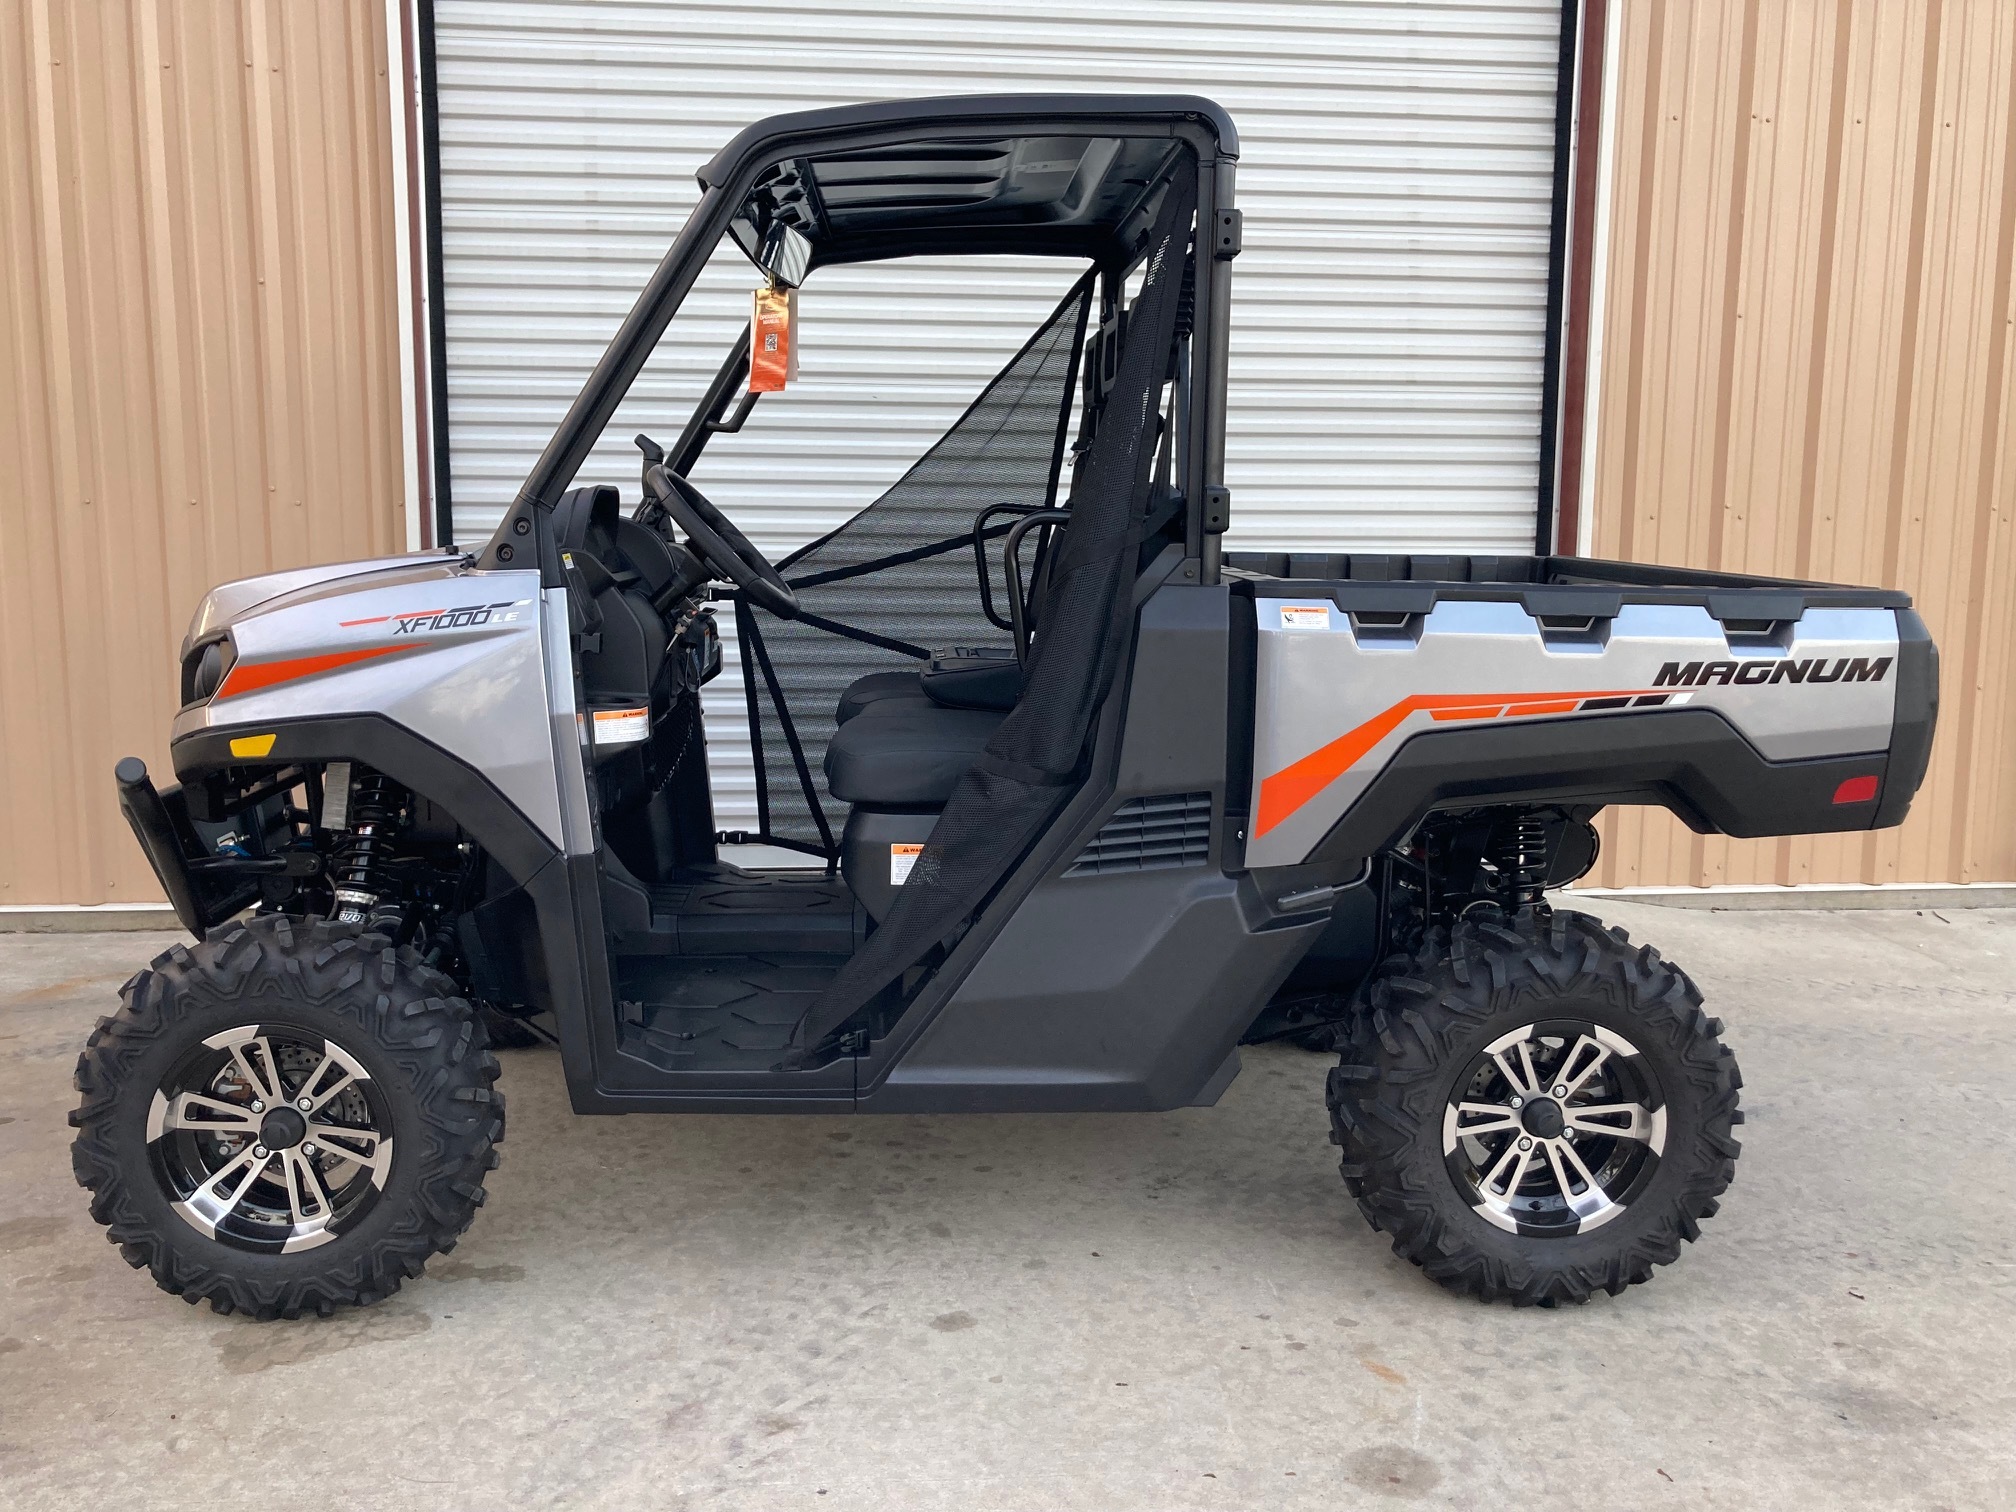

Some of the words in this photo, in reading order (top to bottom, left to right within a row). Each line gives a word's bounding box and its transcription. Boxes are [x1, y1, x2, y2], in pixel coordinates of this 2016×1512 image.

[393, 610, 492, 635] XF1000
[491, 611, 519, 623] LE
[1652, 656, 1893, 686] MAGNUM
